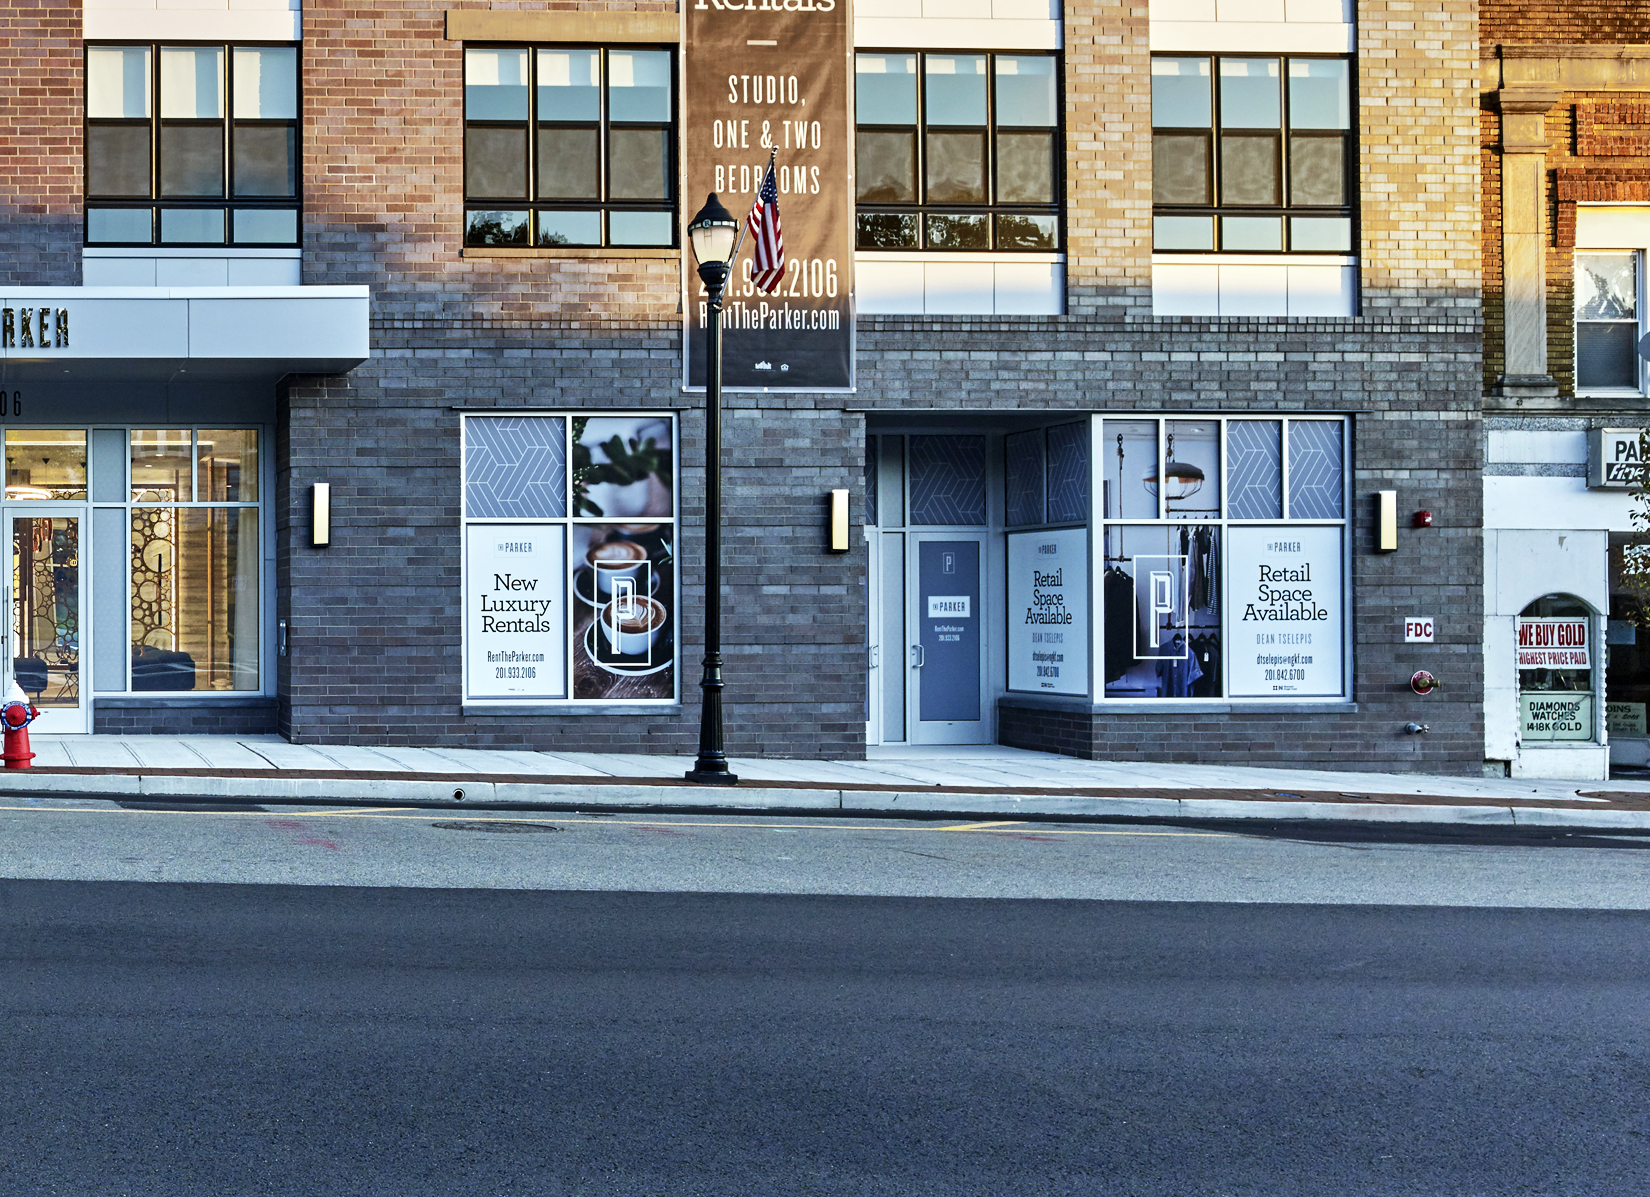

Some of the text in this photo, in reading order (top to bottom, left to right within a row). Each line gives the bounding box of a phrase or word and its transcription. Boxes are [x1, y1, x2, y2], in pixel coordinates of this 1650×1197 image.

[728, 74, 806, 106] STUDIO,
[713, 119, 822, 150] ONE & TWO
[715, 165, 821, 195] BEDROMS
[699, 301, 840, 331] RntTheParker.com
[505, 542, 533, 553] PARKER
[1274, 541, 1301, 553] PARKER
[1033, 567, 1063, 587] Retail
[1259, 562, 1312, 582] Retail
[493, 573, 538, 591] New
[1033, 589, 1064, 610] Space
[1258, 584, 1312, 606] Space
[480, 594, 552, 616] Luxury
[939, 601, 966, 612] PARKER
[1150, 570, 1175, 648] P
[1242, 601, 1328, 621] Available
[481, 614, 551, 633] Rentals
[611, 576, 637, 654] P
[1025, 606, 1072, 625] Available
[1406, 622, 1433, 637] FDC
[1519, 624, 1585, 646] WE BUY GOLD
[1256, 633, 1312, 645] DEAN TSELEPIS
[487, 650, 545, 663] RentTheParker.com
[1256, 652, 1313, 667] dtselepis@ngkf.com
[1519, 651, 1587, 665] HIGHEST PRICE PAID
[495, 667, 537, 679] 201.933.2106
[1264, 668, 1305, 681] 201.842.6700
[1529, 702, 1580, 711] DIAMONDS
[1606, 704, 1631, 714] OINS
[1532, 711, 1576, 721] WATCHES
[1552, 722, 1582, 731] GOLD
